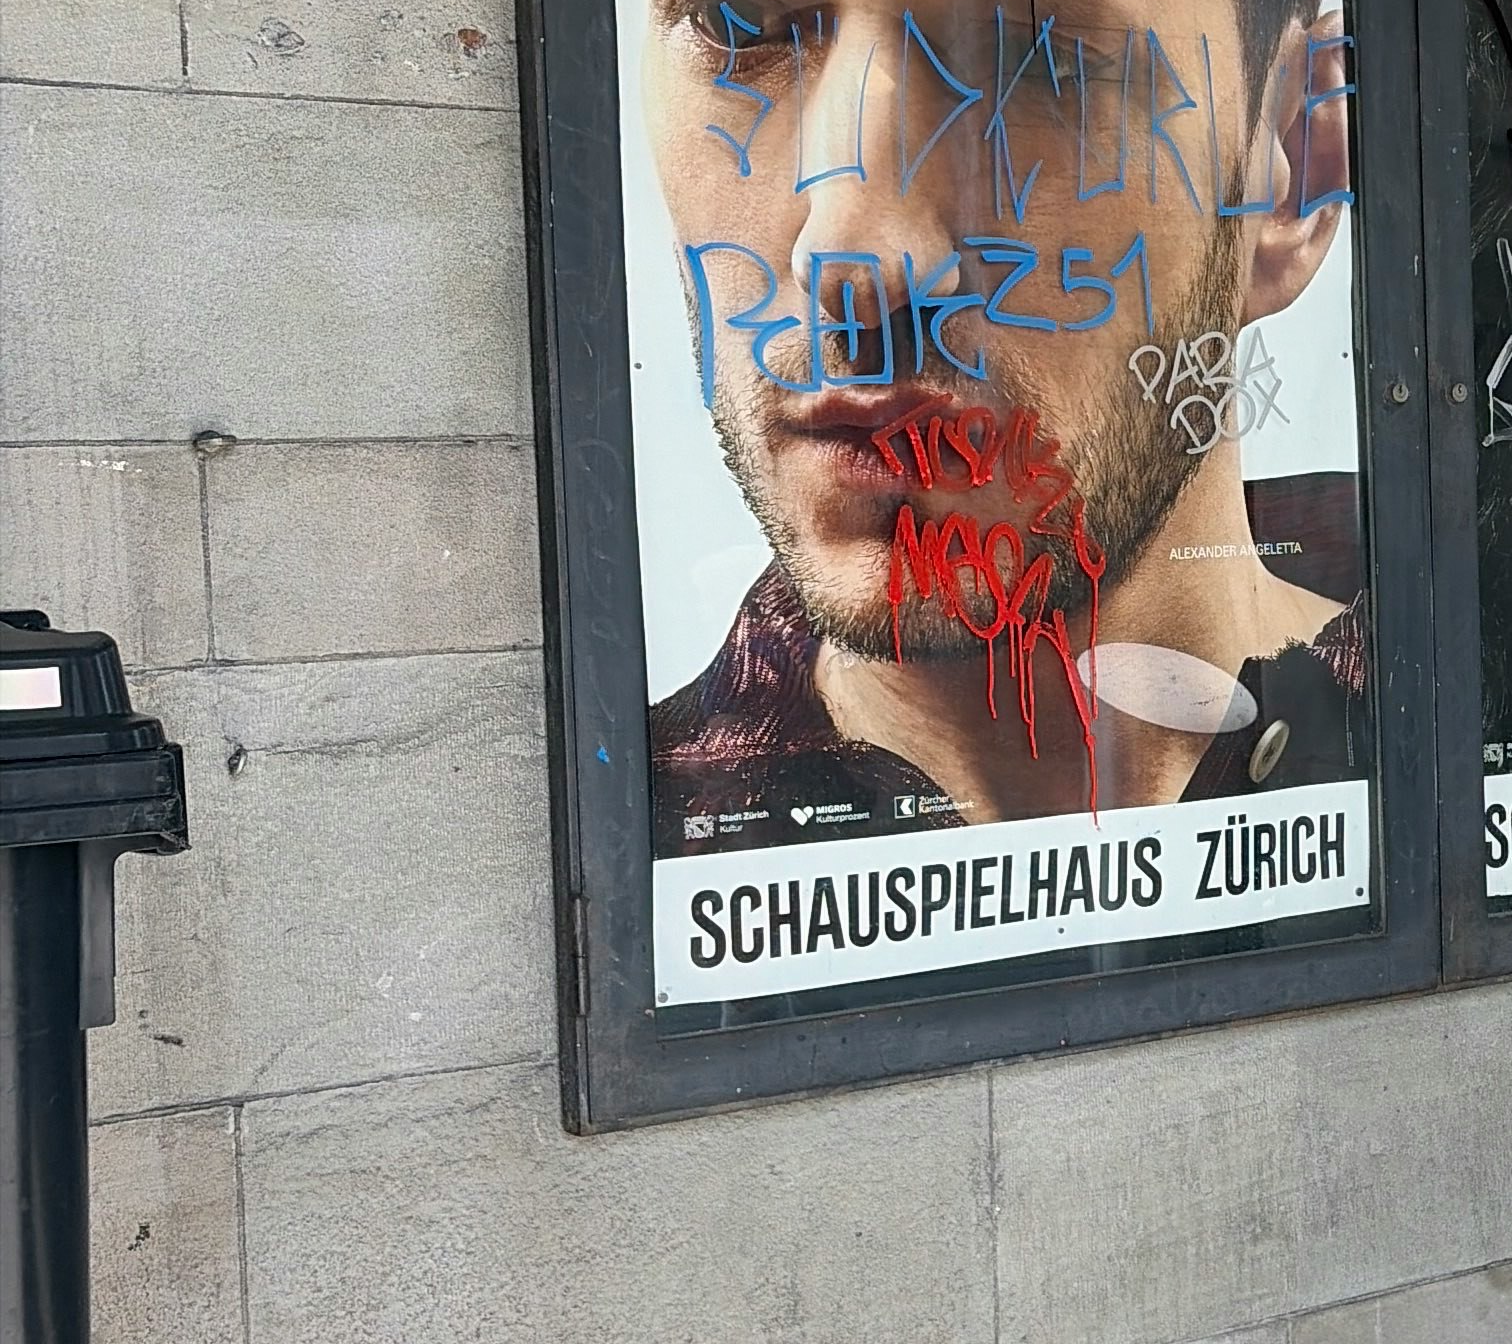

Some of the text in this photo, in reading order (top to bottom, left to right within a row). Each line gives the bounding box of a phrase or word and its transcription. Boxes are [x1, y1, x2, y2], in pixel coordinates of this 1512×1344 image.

[1169, 541, 1303, 561] ALEXANDER ANGELETTA
[918, 795, 950, 806] Zürcher
[918, 799, 975, 814] Kantonalbank
[815, 803, 853, 814] MIGROS
[718, 809, 770, 823] Stadt Zürich
[815, 811, 870, 824] Kulturprozent
[718, 823, 744, 834] Kultur
[689, 812, 1346, 969] SCHAUSPIELHAUS ZÜRICH
